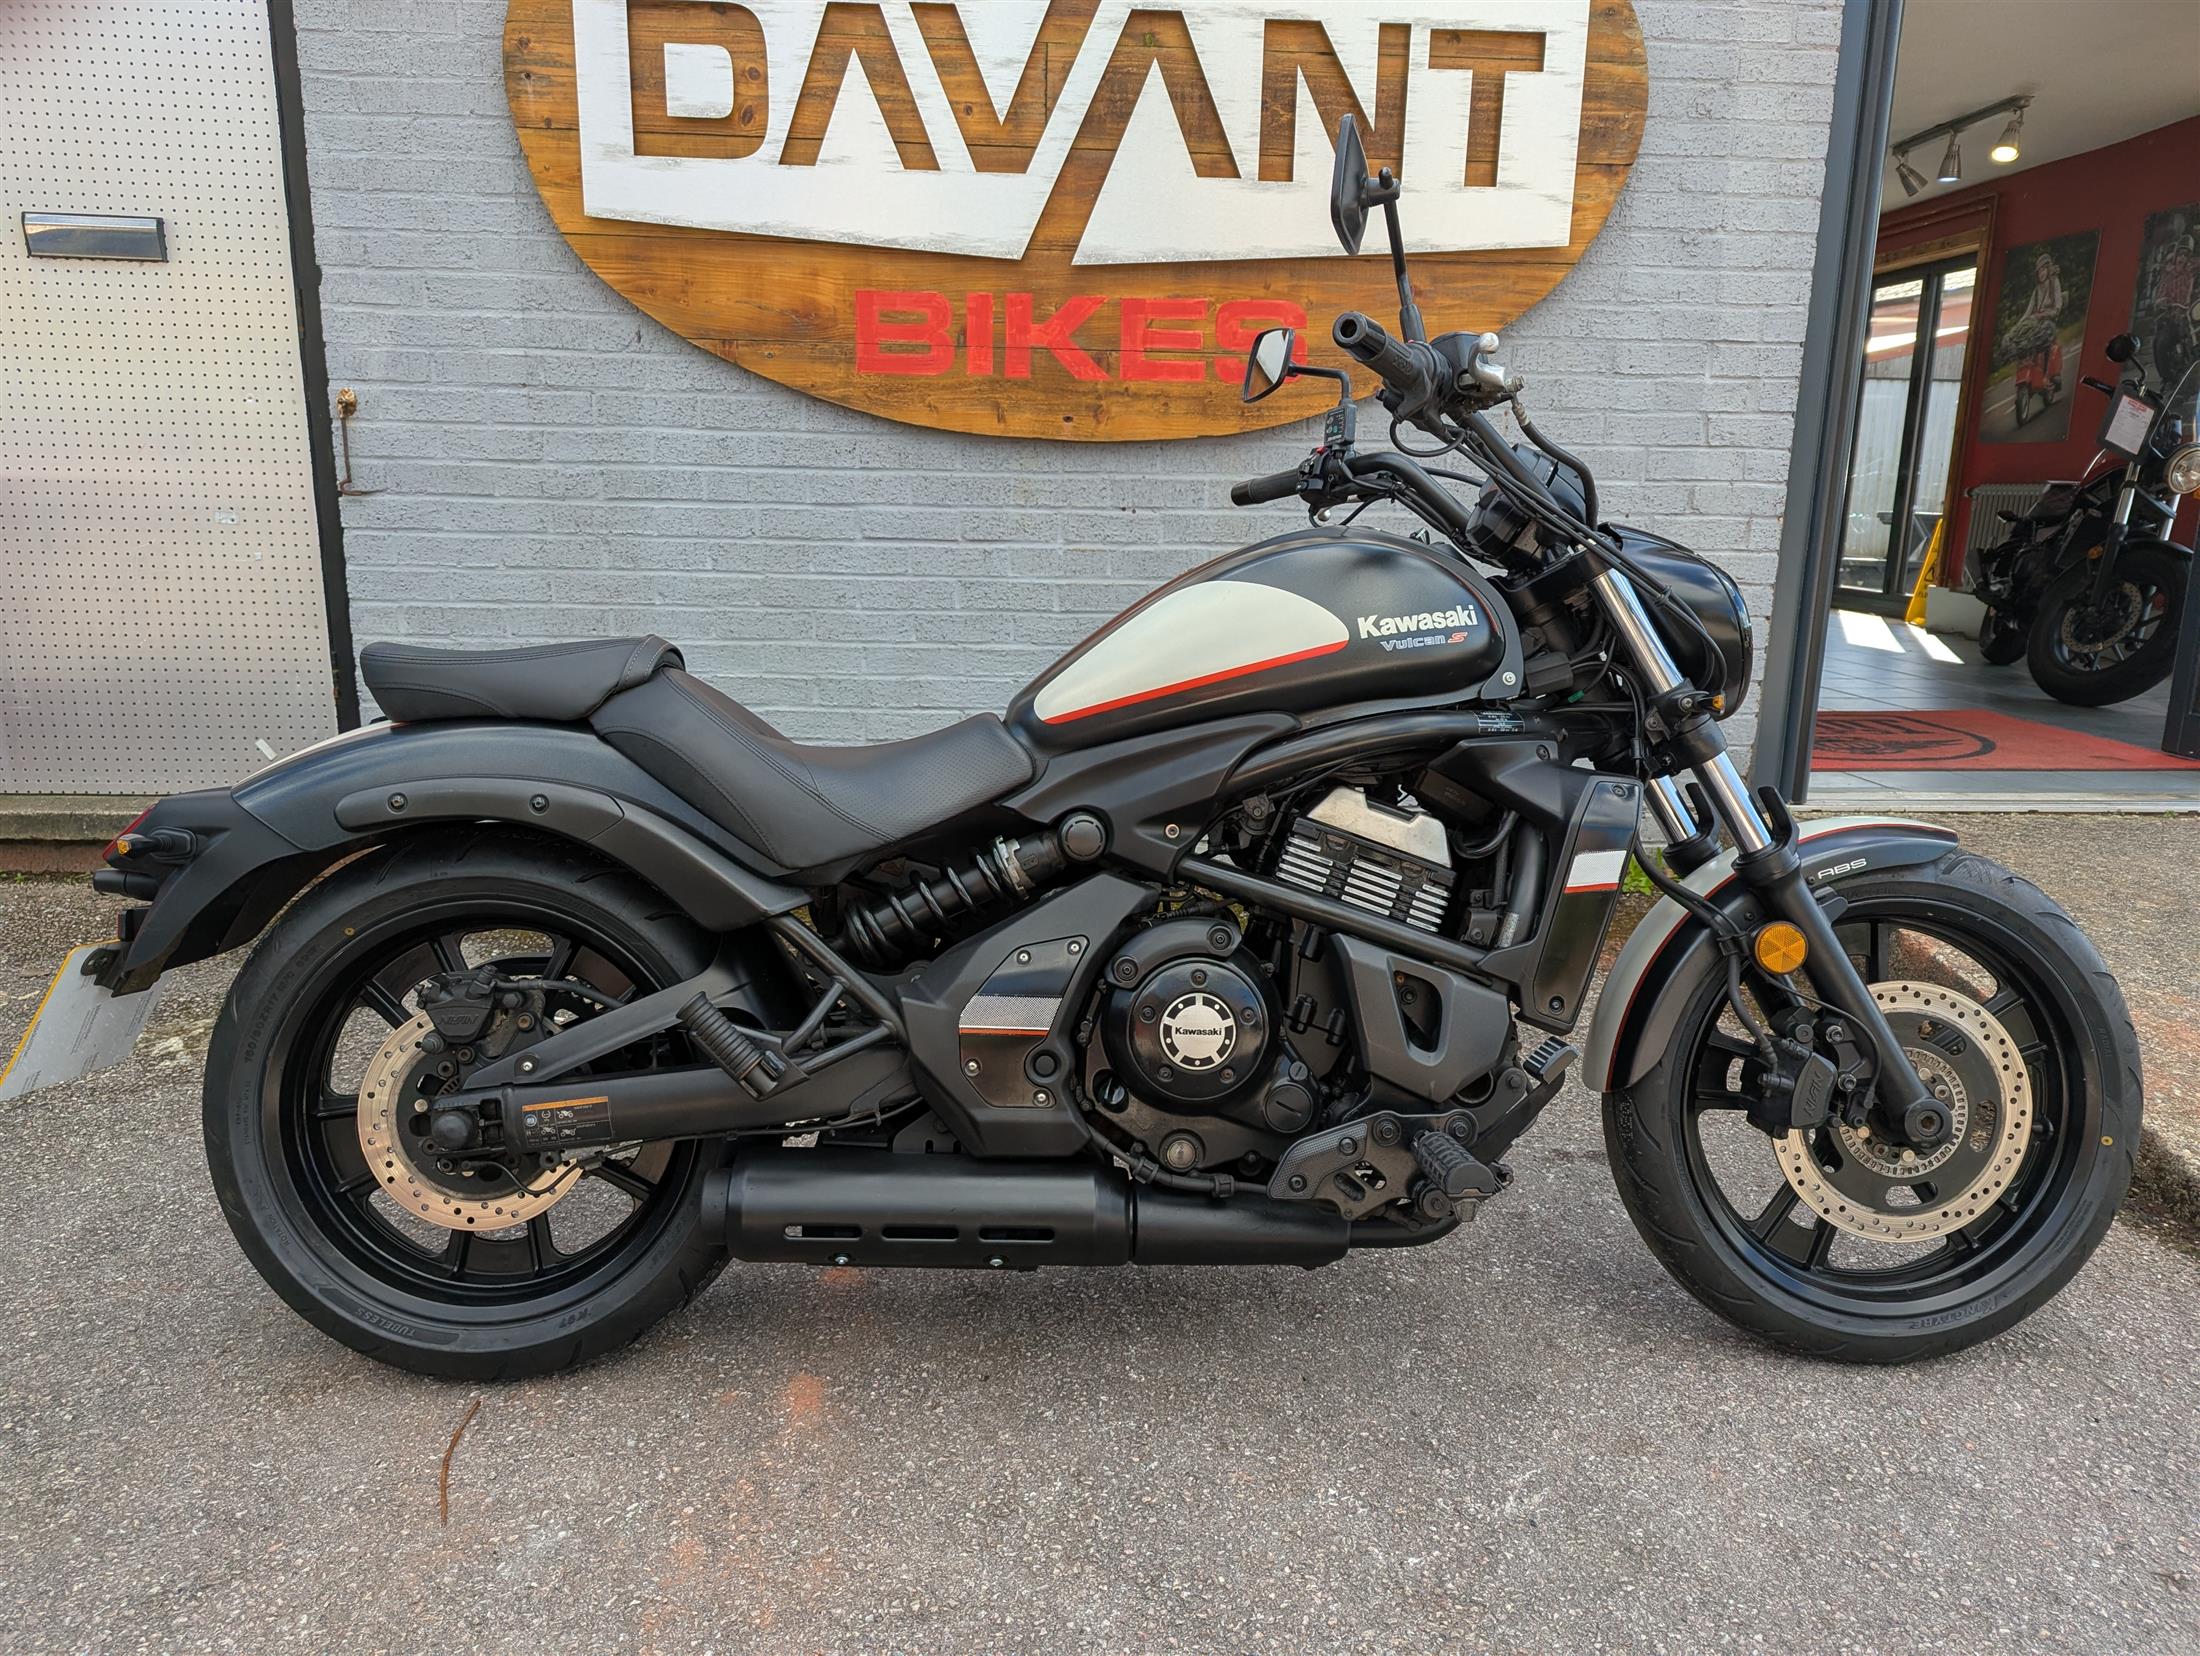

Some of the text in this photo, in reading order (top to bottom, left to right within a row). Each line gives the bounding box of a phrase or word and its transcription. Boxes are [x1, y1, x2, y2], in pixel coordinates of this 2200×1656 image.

[628, 0, 1547, 225] DAVANT
[855, 289, 1310, 384] BIKES
[1357, 604, 1479, 640] Kawasaki
[1380, 631, 1469, 652] Vulcan S
[1817, 858, 1868, 880] ABS
[1174, 1026, 1222, 1036] Kawasaki
[355, 1307, 417, 1337] TUBELESS
